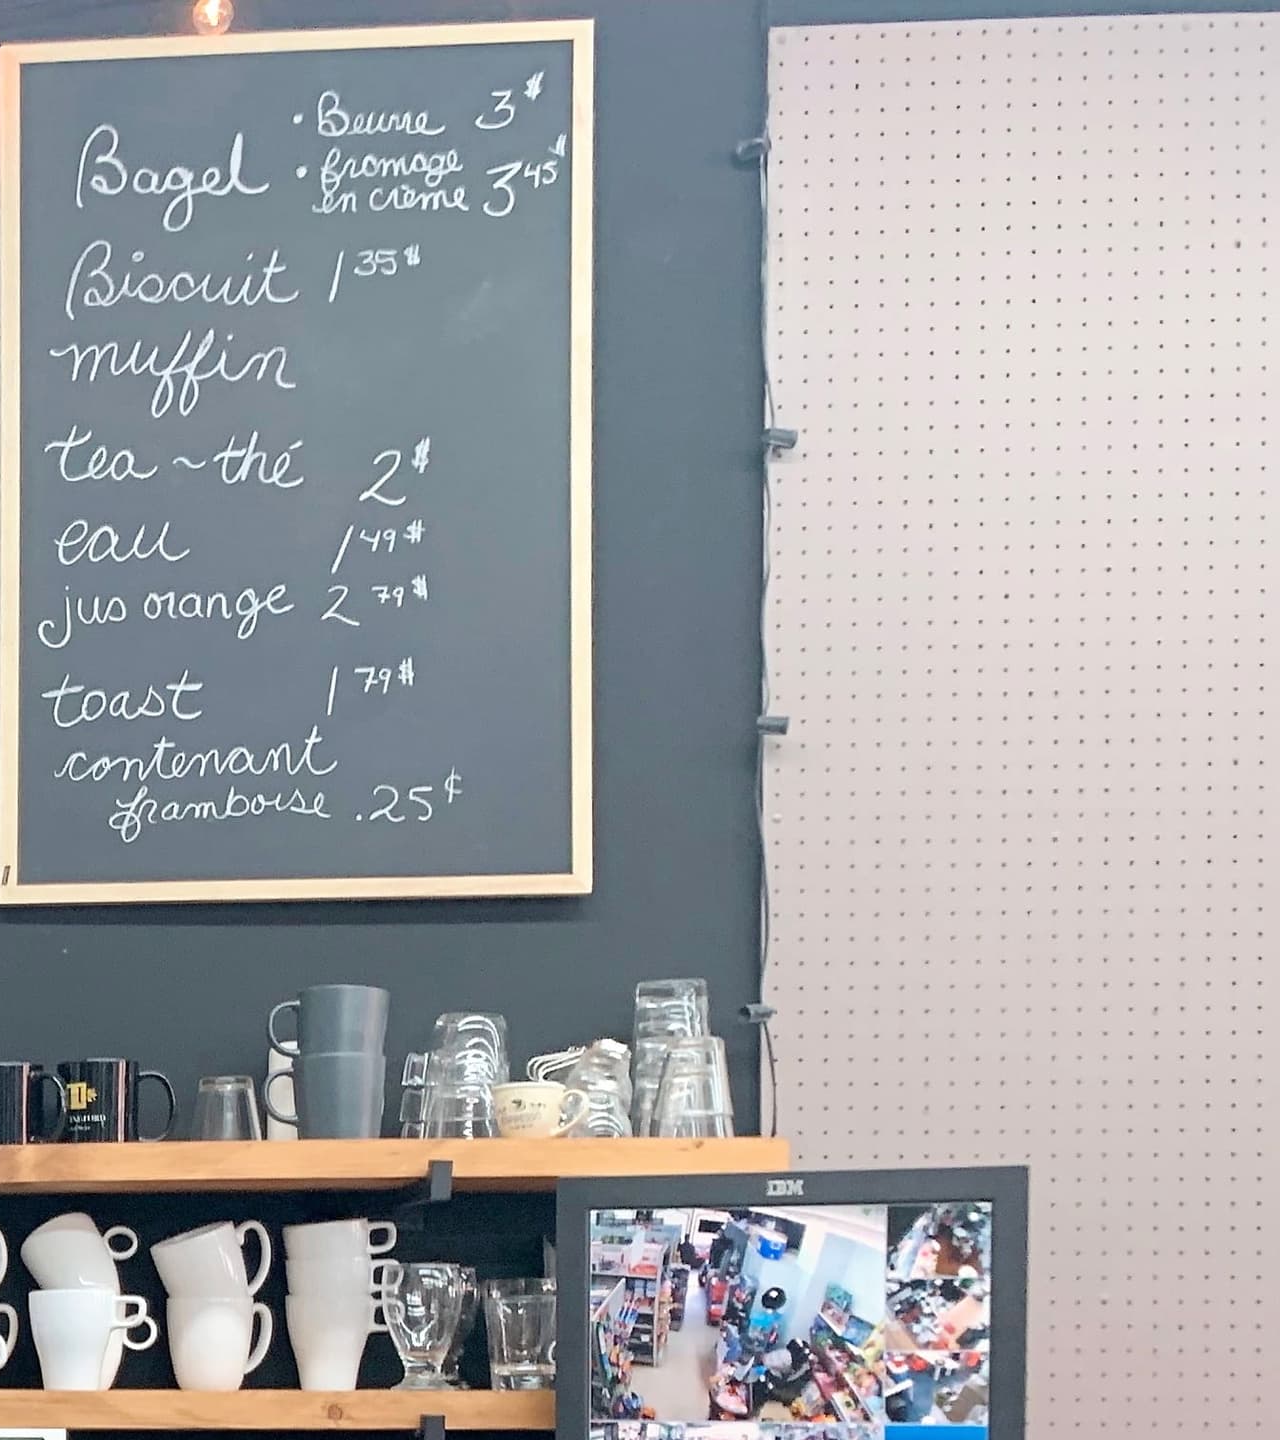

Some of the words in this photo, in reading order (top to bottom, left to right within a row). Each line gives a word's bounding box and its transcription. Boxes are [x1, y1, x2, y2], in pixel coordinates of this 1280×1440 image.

[75, 124, 270, 232] Bagel
[320, 147, 464, 186] fromage
[312, 181, 358, 214] en
[369, 181, 469, 214] crème
[66, 241, 299, 320] Biscuit
[45, 425, 158, 482] tea
[214, 430, 304, 488] thé
[54, 519, 189, 565] eau
[38, 585, 127, 648] jus
[144, 584, 294, 639] orange
[41, 669, 203, 728] toast
[54, 725, 338, 784] contenant
[109, 785, 331, 843] framboise
[766, 1179, 804, 1196] IBM
